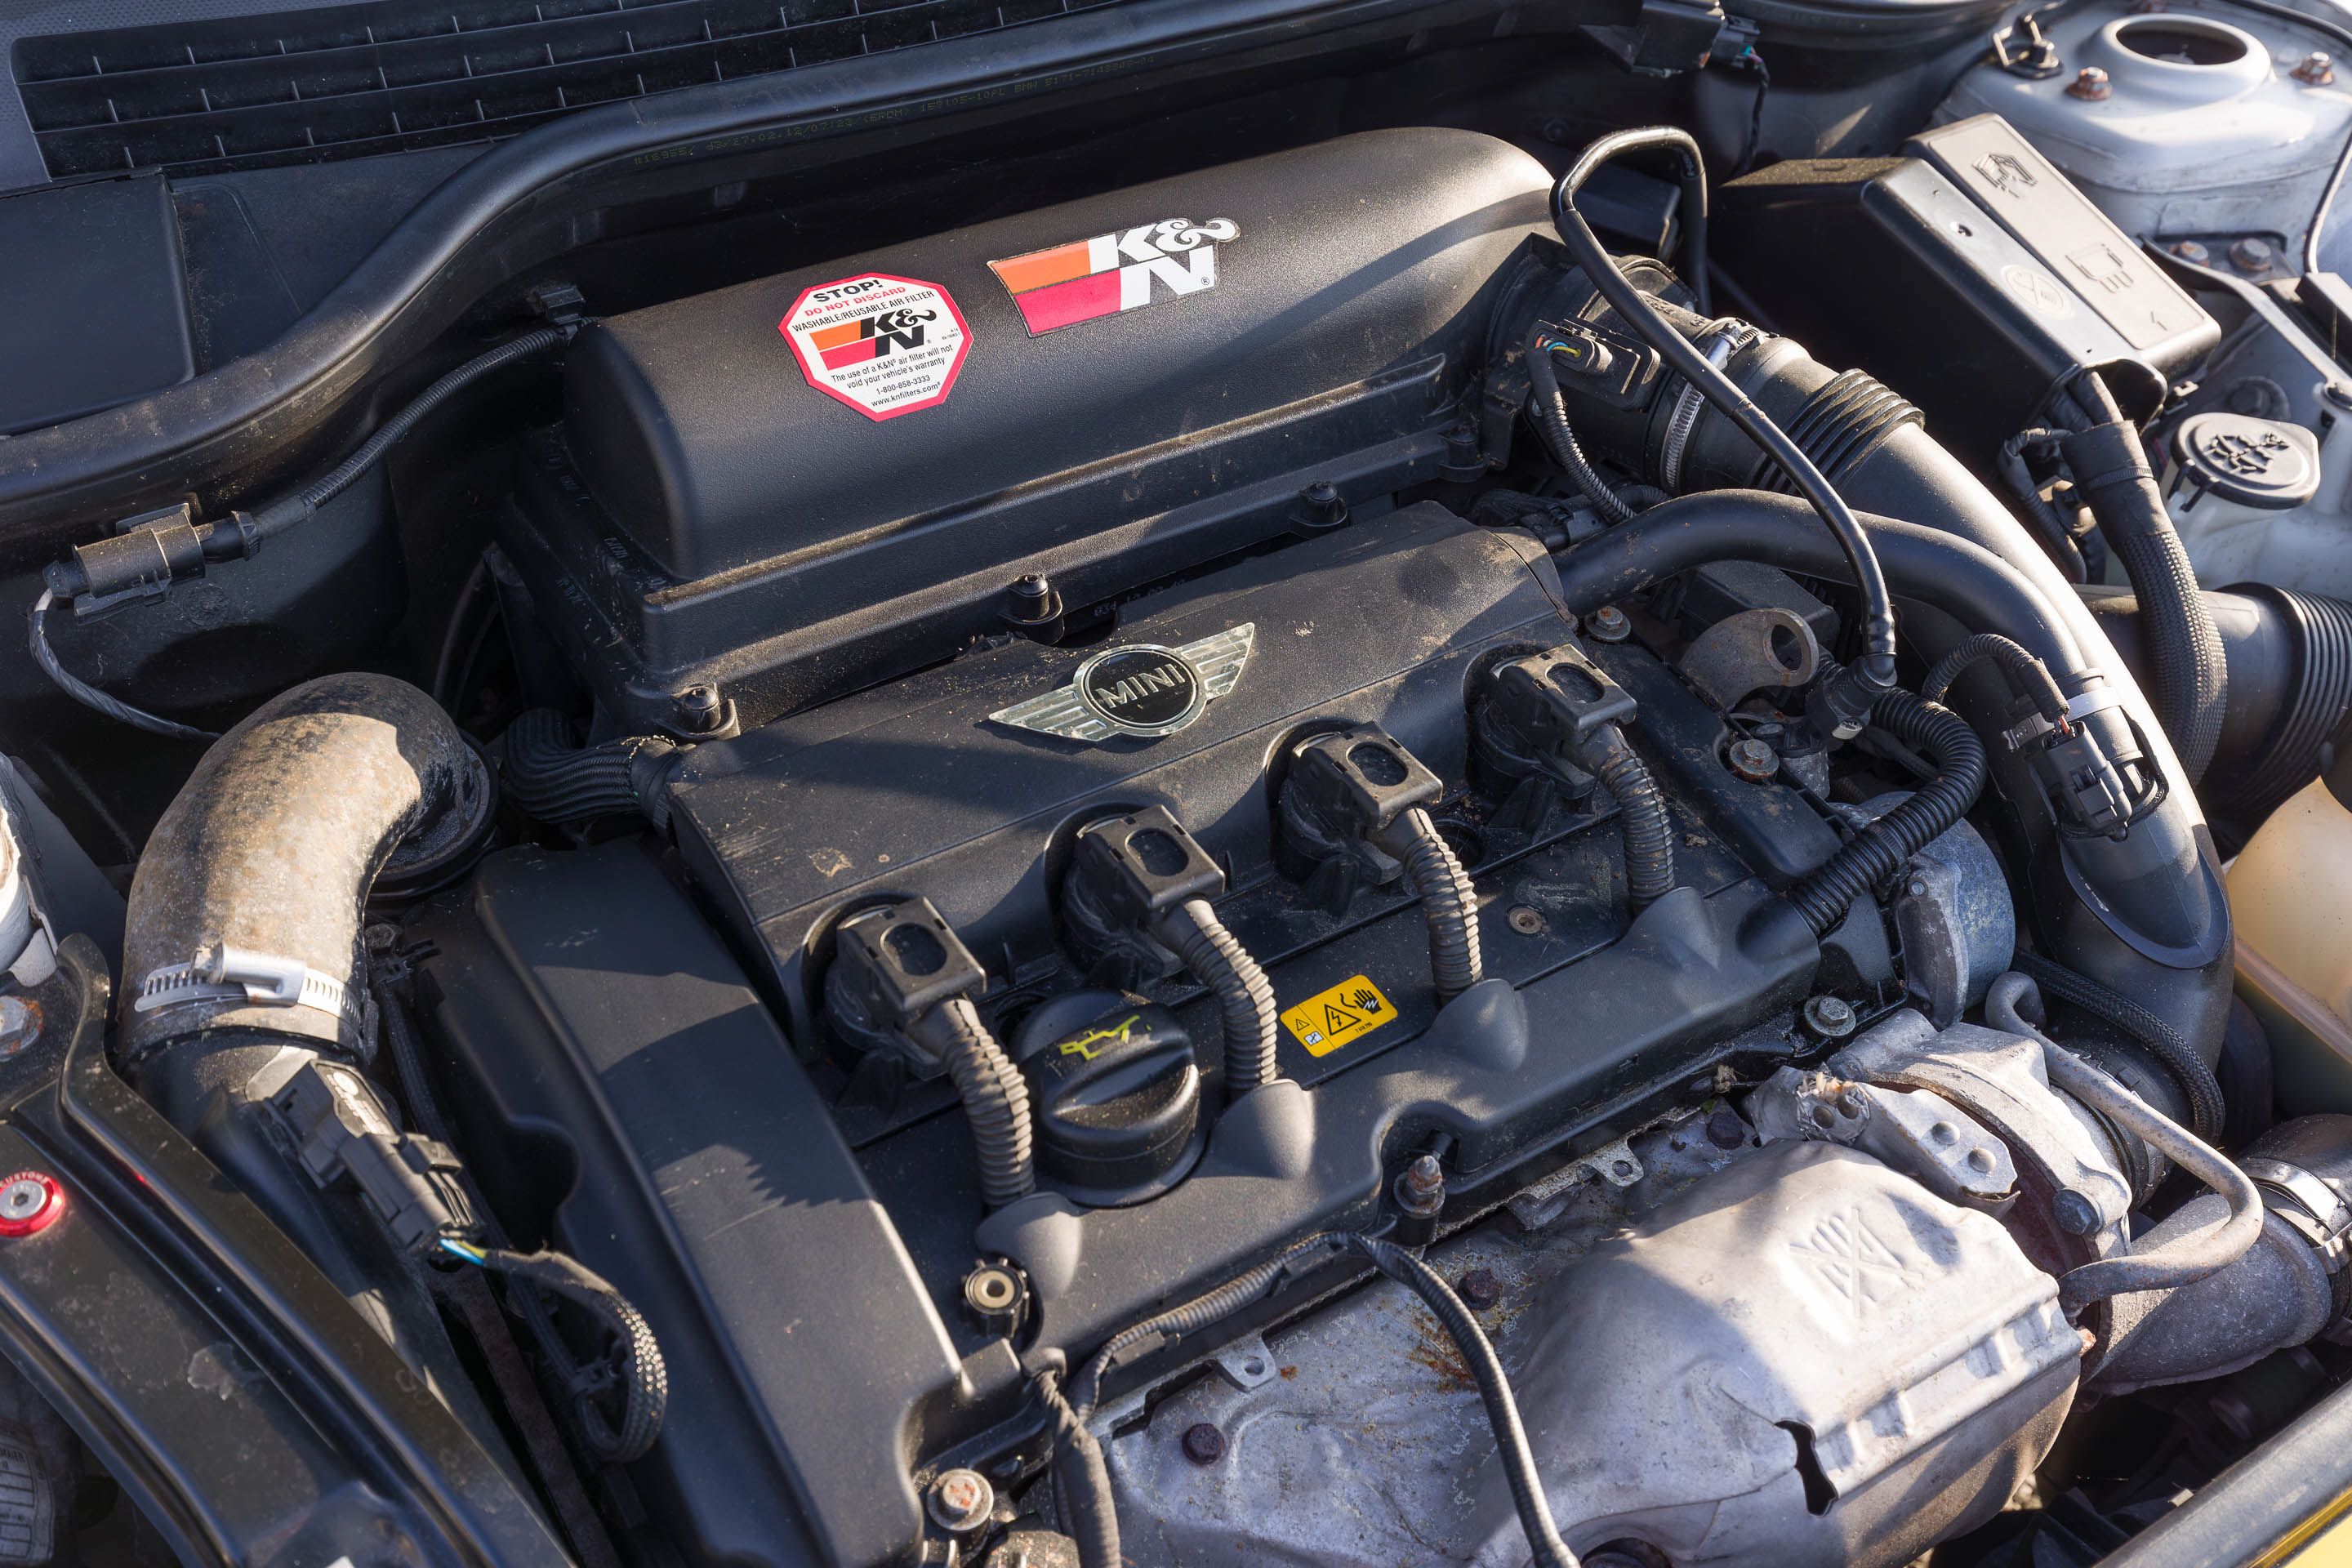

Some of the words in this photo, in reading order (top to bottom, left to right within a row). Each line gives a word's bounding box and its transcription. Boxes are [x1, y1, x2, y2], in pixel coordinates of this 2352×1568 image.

[804, 307, 822, 317] DO
[825, 301, 850, 311] NOT
[854, 287, 906, 304] DISCARD
[813, 279, 884, 302] STOP!
[792, 302, 889, 332] WASHABLE/REUSABLE
[889, 297, 906, 309] AIR
[906, 290, 935, 304] FILTER
[831, 373, 846, 383] The
[848, 371, 861, 379] use
[862, 365, 871, 375] of
[898, 355, 908, 365] air
[909, 351, 925, 363] filter
[926, 348, 939, 359] will
[941, 344, 953, 354] not
[846, 378, 863, 390] void
[864, 375, 881, 386] your
[914, 357, 946, 372] warranty
[875, 374, 931, 395] 1-800-858-3333
[1095, 663, 1186, 709] MINI
